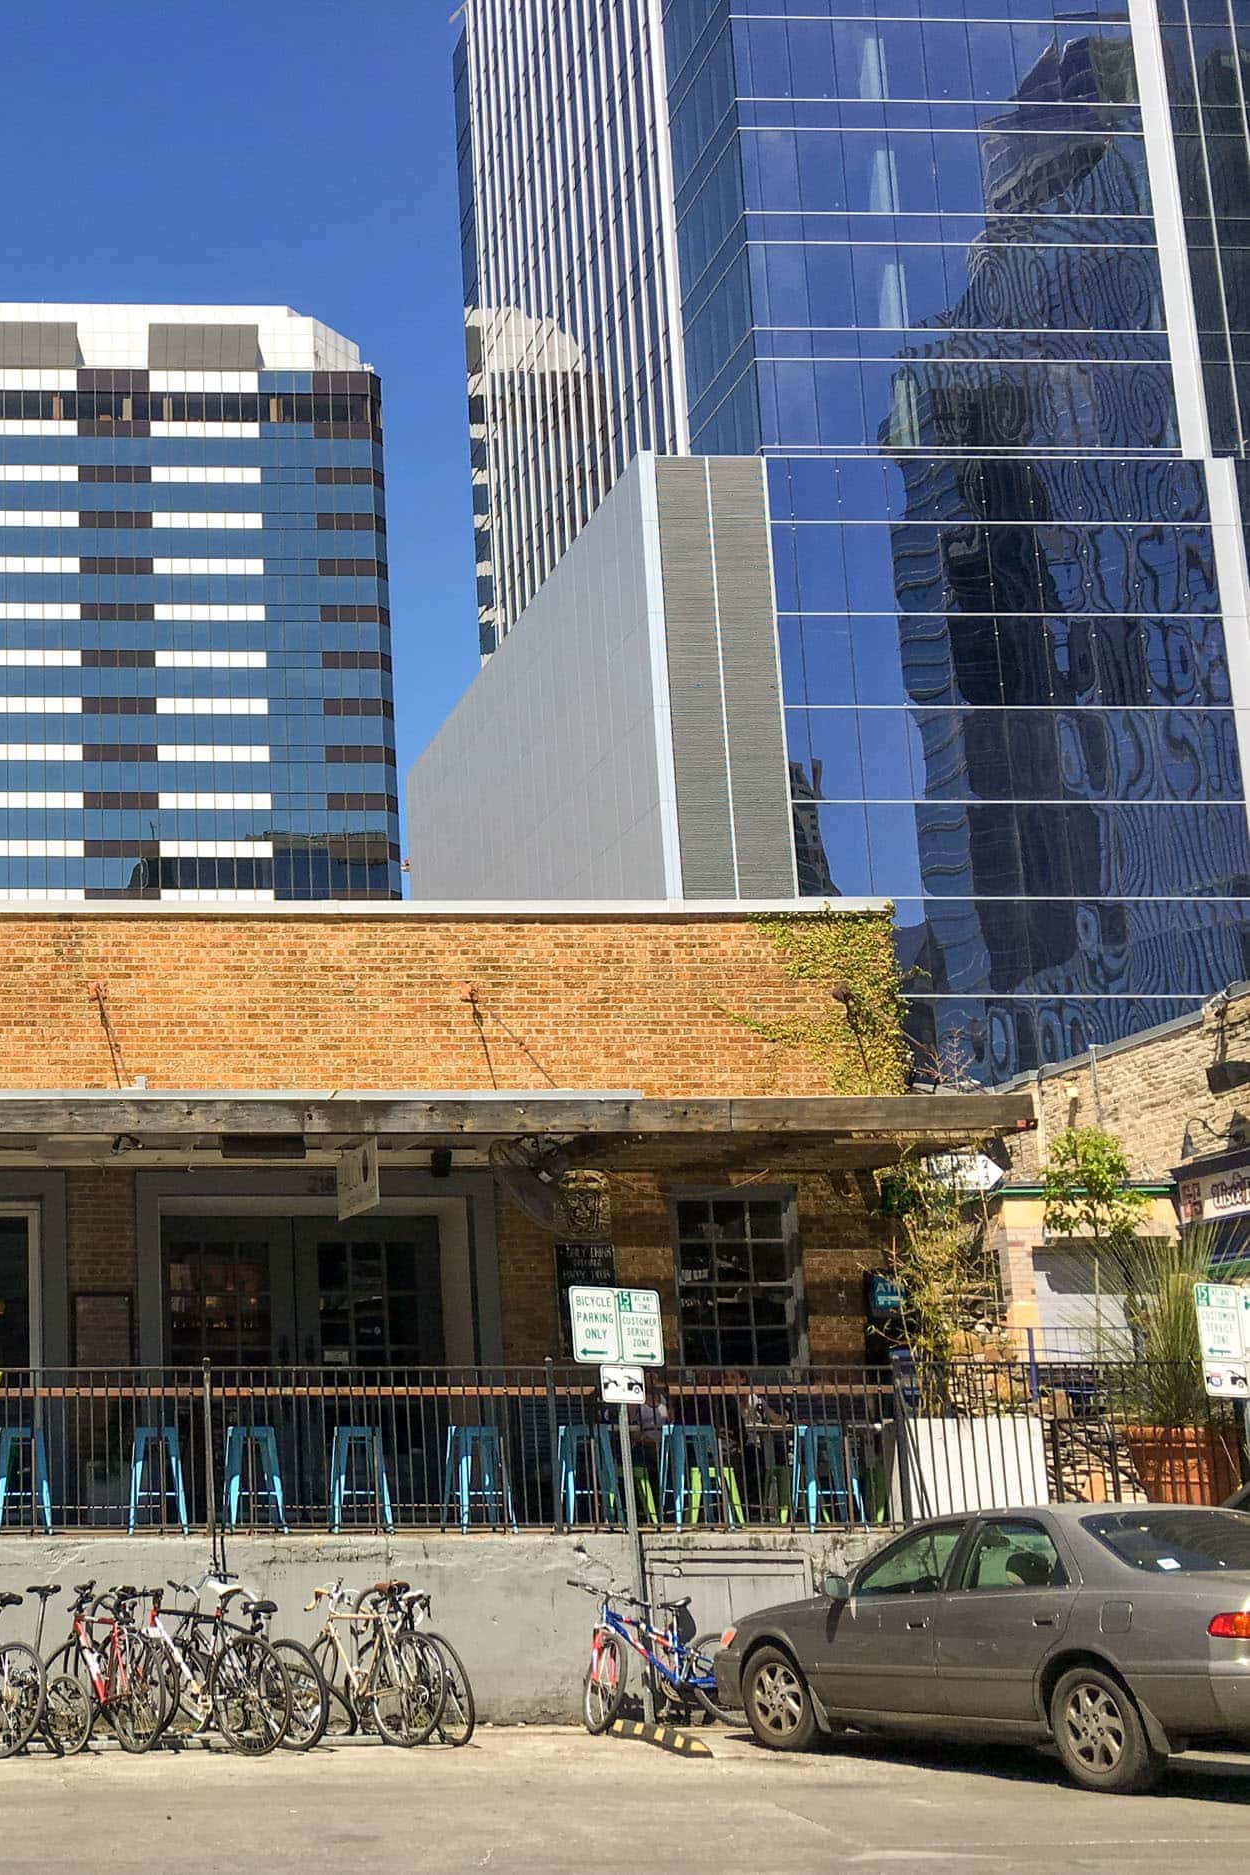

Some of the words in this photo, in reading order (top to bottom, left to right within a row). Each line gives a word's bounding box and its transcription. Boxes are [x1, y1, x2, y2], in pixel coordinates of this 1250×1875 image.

[576, 1295, 611, 1308] BICYCLE
[618, 1292, 630, 1305] 15
[576, 1311, 614, 1324] PARKING
[622, 1316, 657, 1326] CUSTOMER
[585, 1328, 607, 1340] ONLY
[627, 1327, 654, 1337] SERVICE
[633, 1338, 650, 1348] ZONE
